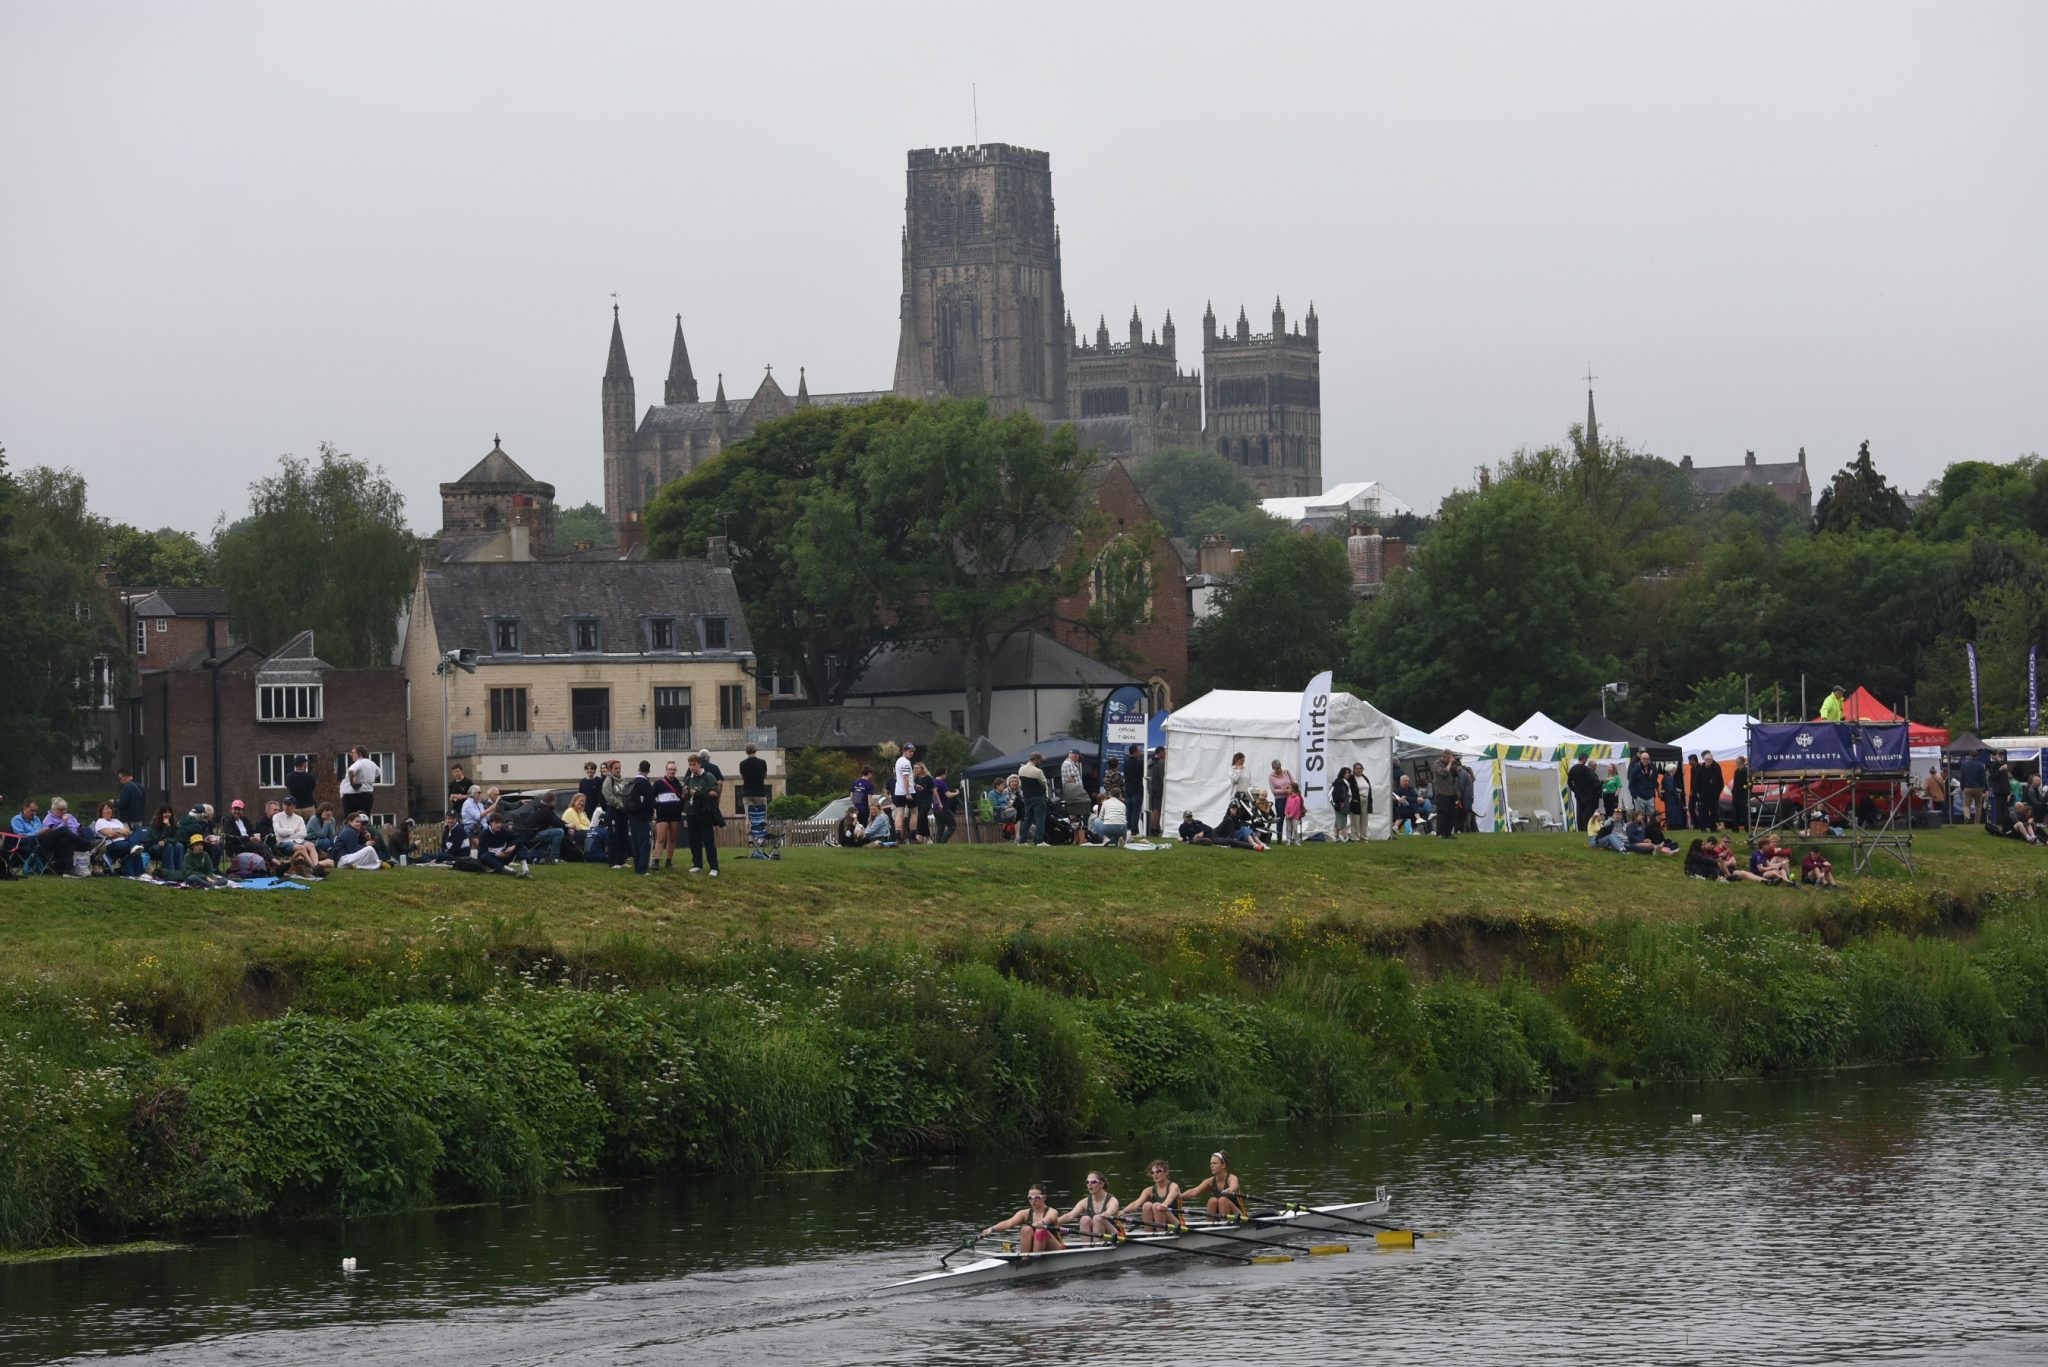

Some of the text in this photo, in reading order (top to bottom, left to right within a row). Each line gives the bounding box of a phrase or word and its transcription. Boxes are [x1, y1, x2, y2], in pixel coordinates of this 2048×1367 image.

[1304, 694, 1328, 797] T Shirts
[1767, 752, 1841, 761] DURHAM REGATTA
